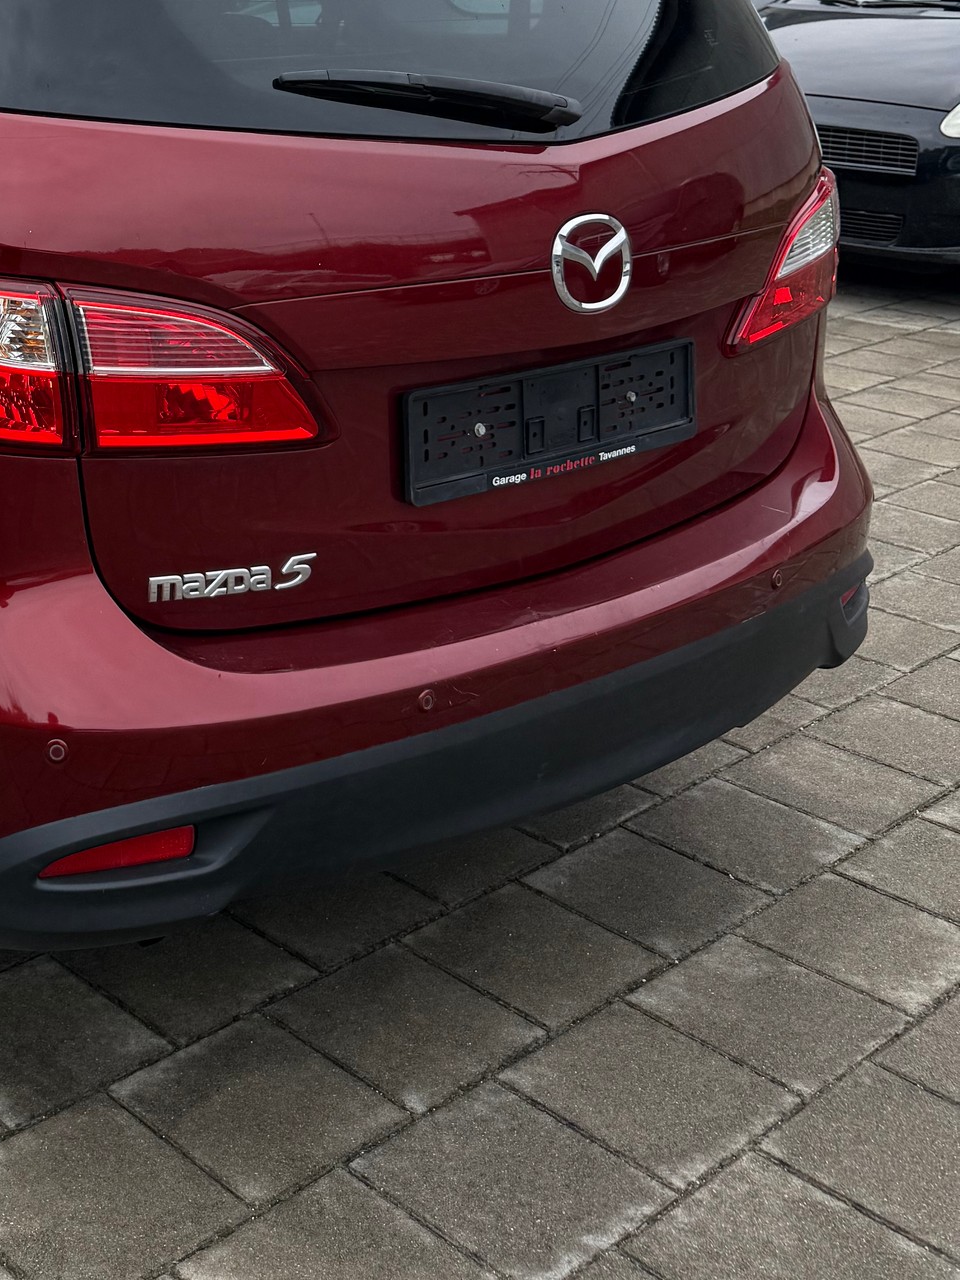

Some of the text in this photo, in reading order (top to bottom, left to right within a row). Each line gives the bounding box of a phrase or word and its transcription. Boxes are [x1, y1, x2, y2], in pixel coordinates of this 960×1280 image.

[492, 445, 636, 487] Garage la rochette Tavannes
[274, 552, 317, 590] 5
